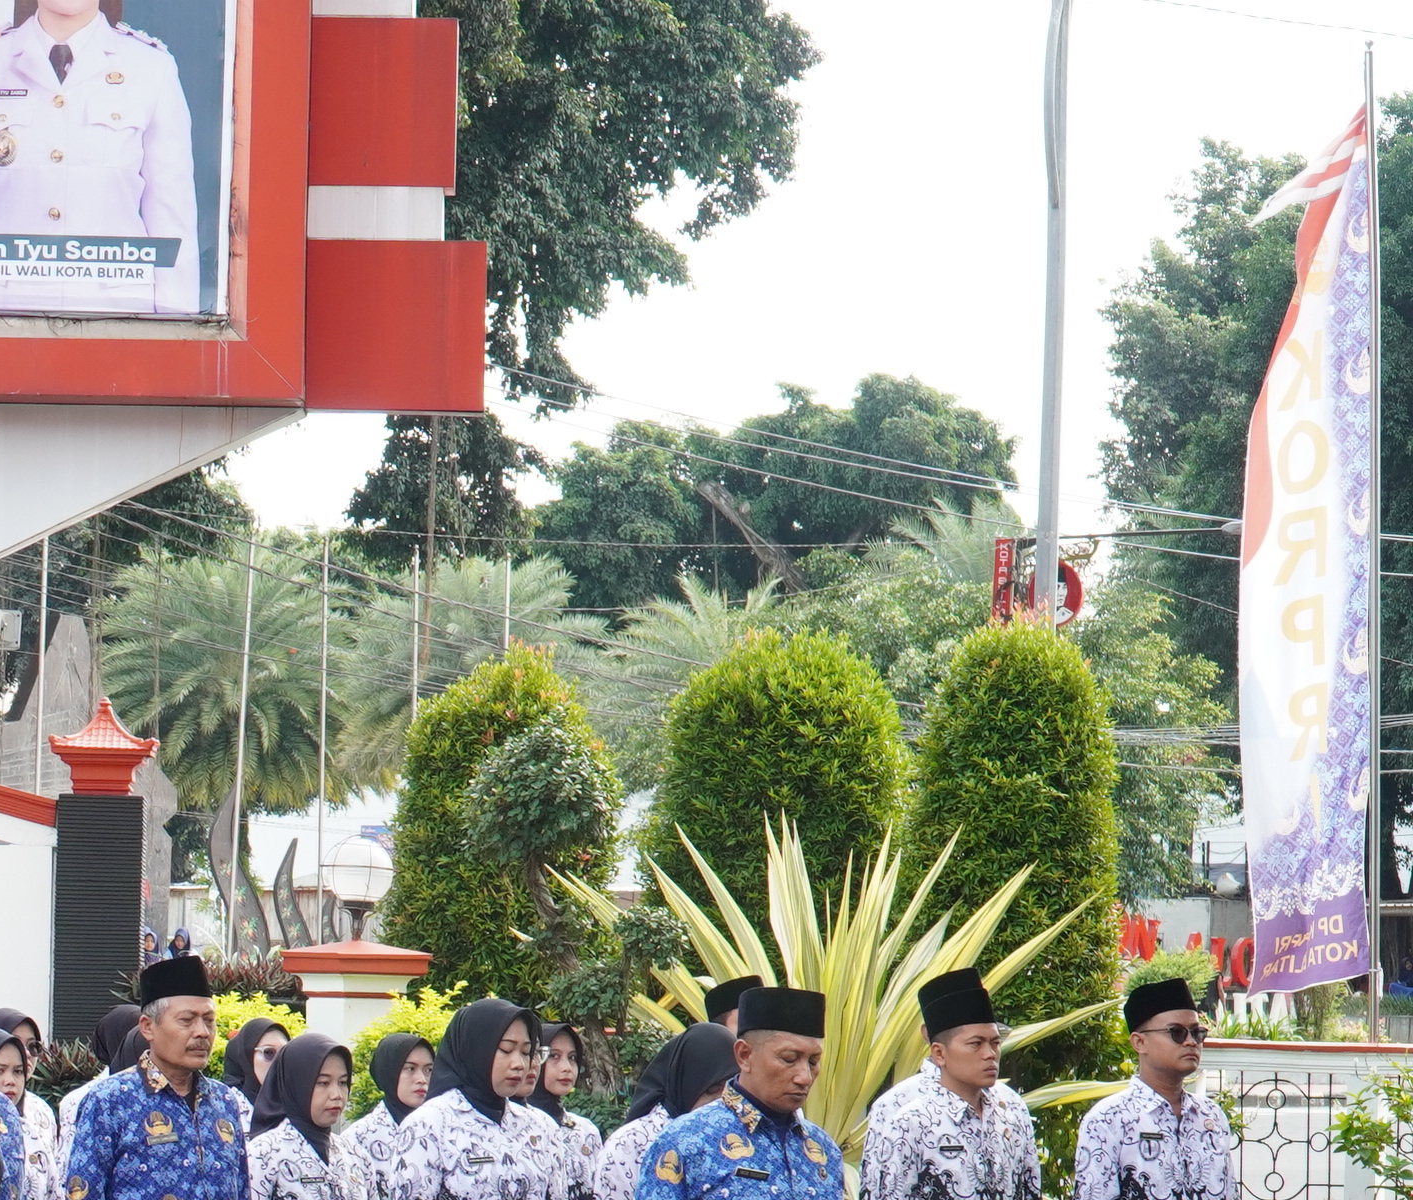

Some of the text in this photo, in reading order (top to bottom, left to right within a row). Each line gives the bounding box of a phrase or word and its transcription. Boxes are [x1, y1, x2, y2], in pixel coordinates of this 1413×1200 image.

[14, 239, 58, 262] Tyu
[65, 240, 157, 262] Samba
[16, 265, 52, 277] WALI
[56, 266, 93, 278] KOTA
[97, 267, 145, 280] BLITAR
